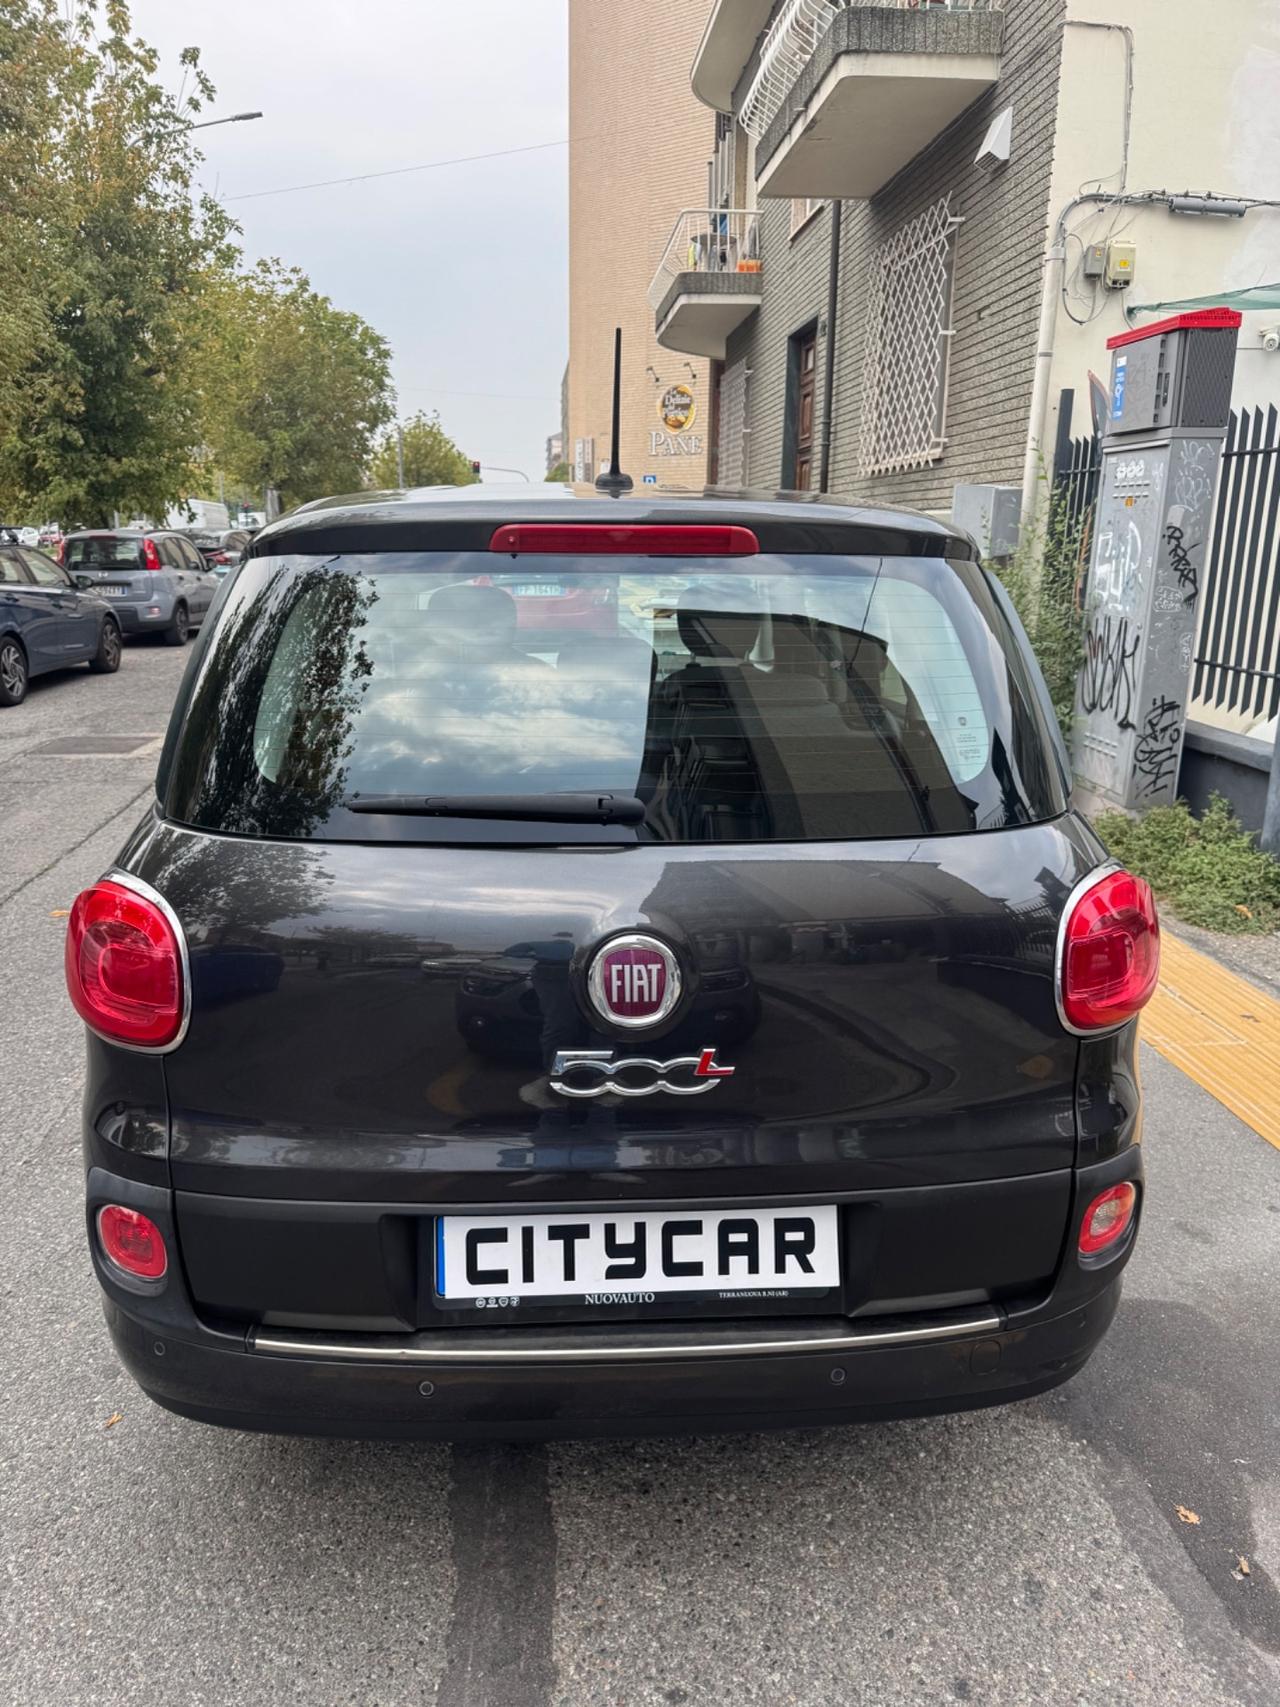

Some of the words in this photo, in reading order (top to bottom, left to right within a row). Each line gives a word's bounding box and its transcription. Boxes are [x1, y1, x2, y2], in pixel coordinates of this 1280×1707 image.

[650, 431, 702, 456] PANE
[611, 964, 662, 1003] FIAT
[550, 1048, 736, 1097] 500L
[465, 1216, 816, 1285] CITYCAR
[585, 1292, 655, 1305] NUOVAUTO
